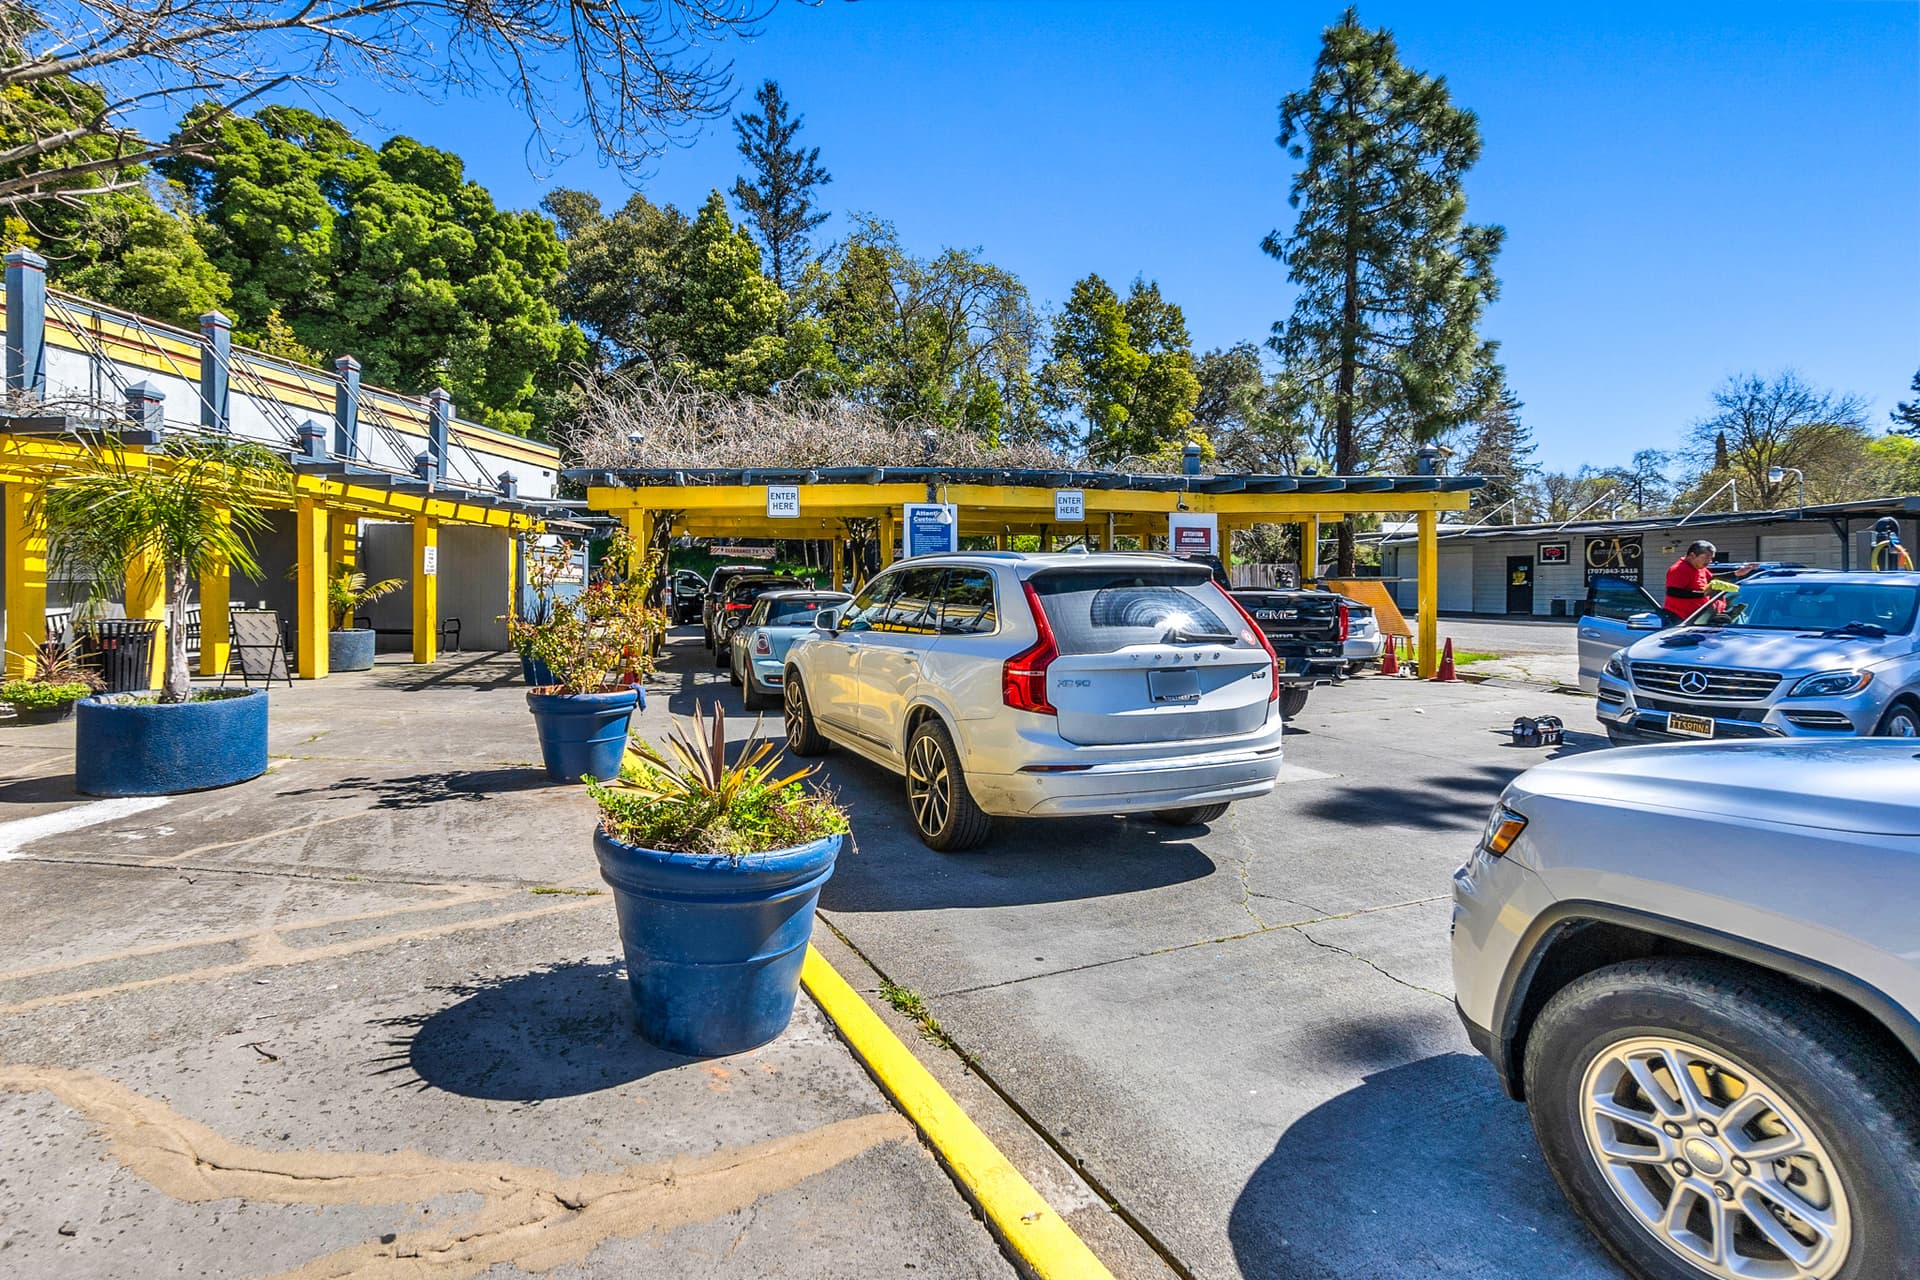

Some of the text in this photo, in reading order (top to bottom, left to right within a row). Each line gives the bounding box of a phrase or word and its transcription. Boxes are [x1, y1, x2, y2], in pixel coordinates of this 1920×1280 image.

[770, 492, 796, 500] ENTER
[1058, 496, 1082, 504] ENTER
[772, 502, 794, 510] HERE
[1060, 506, 1080, 514] HERE
[1255, 609, 1298, 620] GMC
